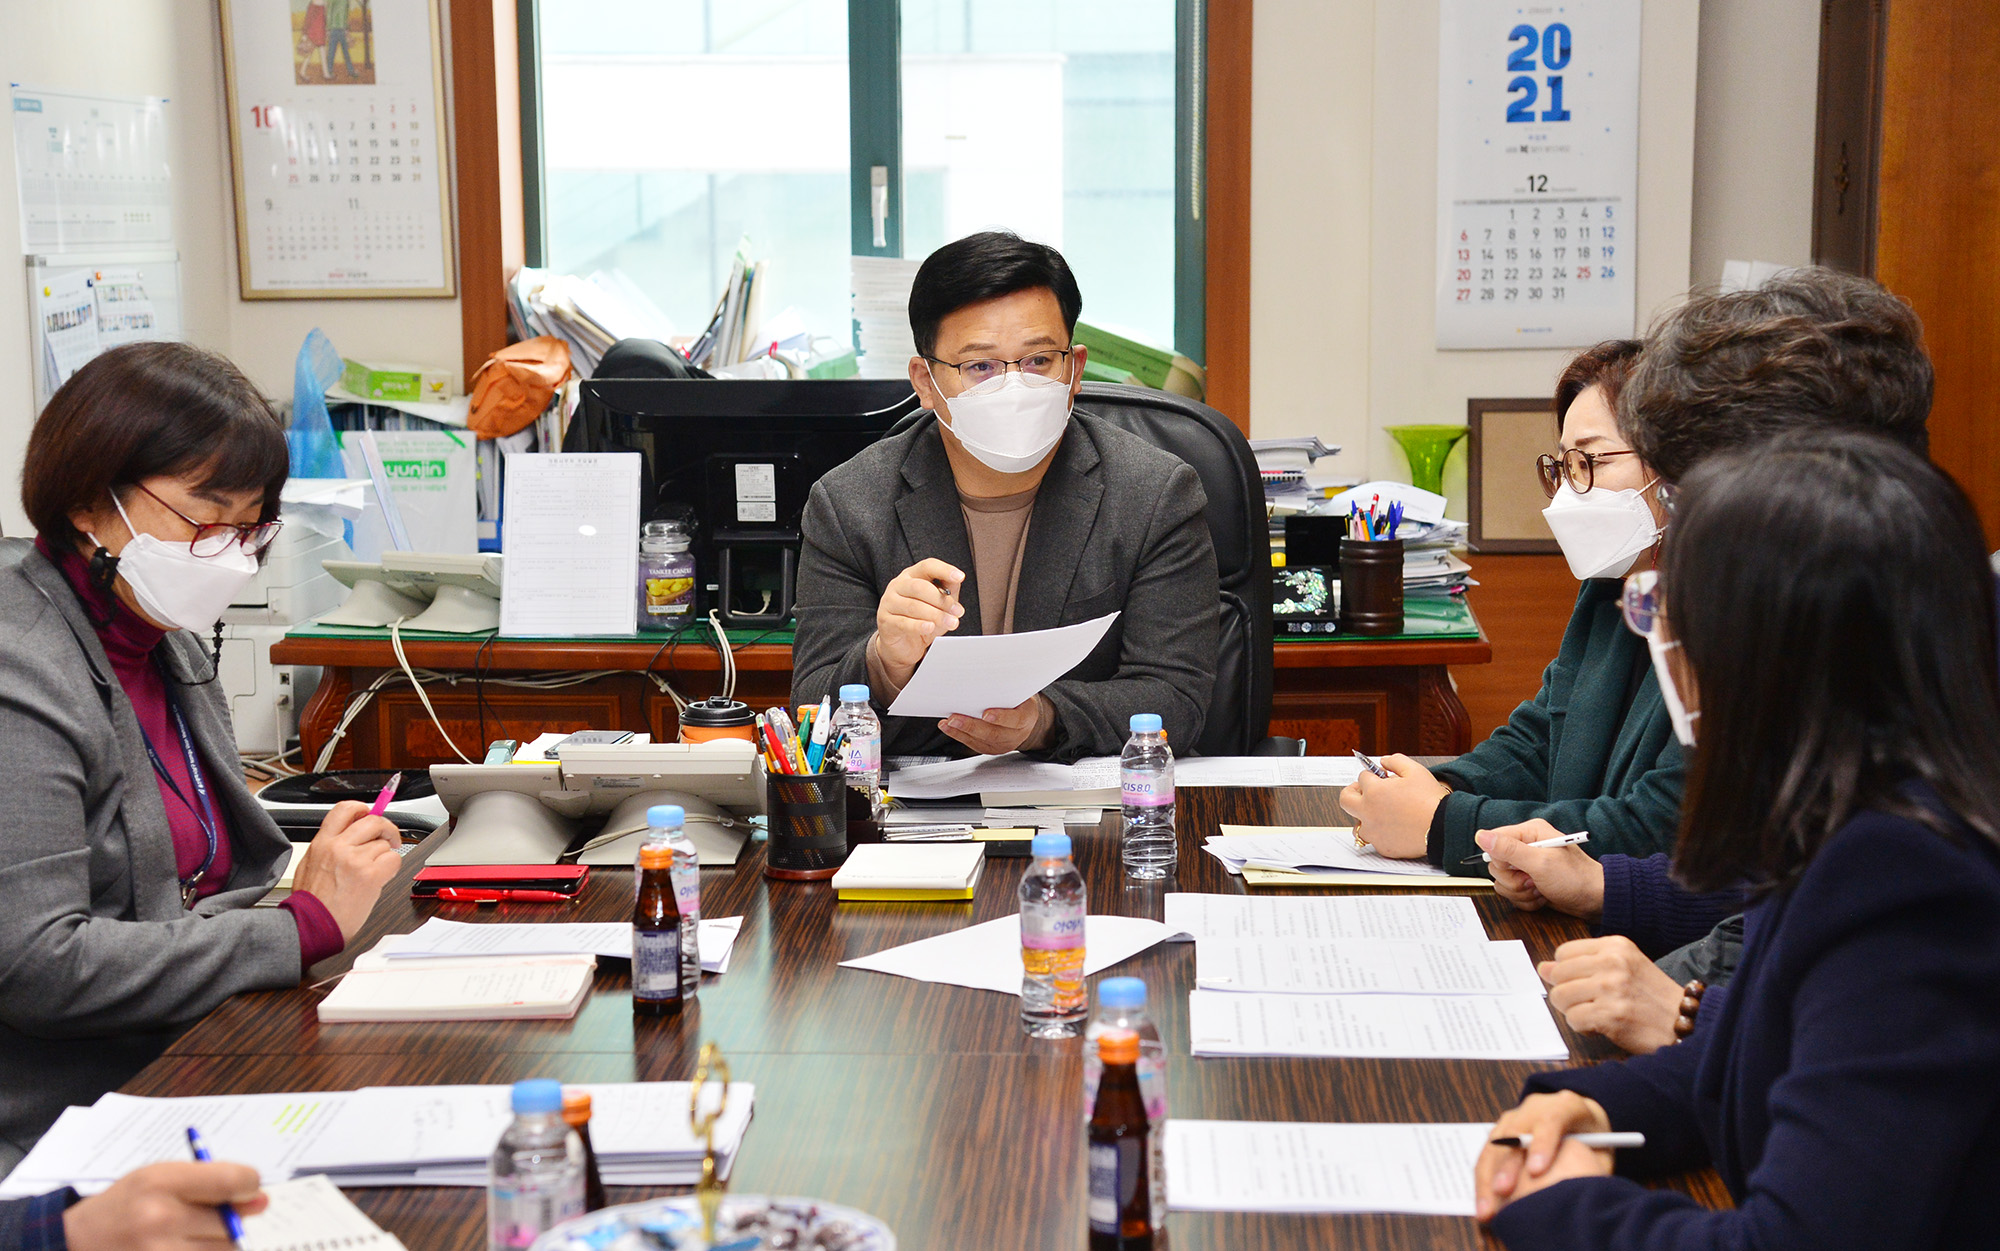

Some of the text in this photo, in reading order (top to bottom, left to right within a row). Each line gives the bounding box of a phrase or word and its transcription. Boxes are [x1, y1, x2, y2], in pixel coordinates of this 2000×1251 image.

[1507, 23, 1571, 71] 20
[1506, 75, 1571, 123] 21
[1527, 174, 1548, 193] 12
[1509, 206, 1613, 220] 1 2 3 4 5
[1461, 226, 1615, 242] 6 7 8 9 10 11 12
[1458, 246, 1614, 262] 13 14 15 16 17 18 19
[1457, 266, 1615, 281] 20 21 22 23 24 25 26
[1457, 287, 1565, 301] 27 28 29 30 31
[383, 460, 442, 479] yunjin
